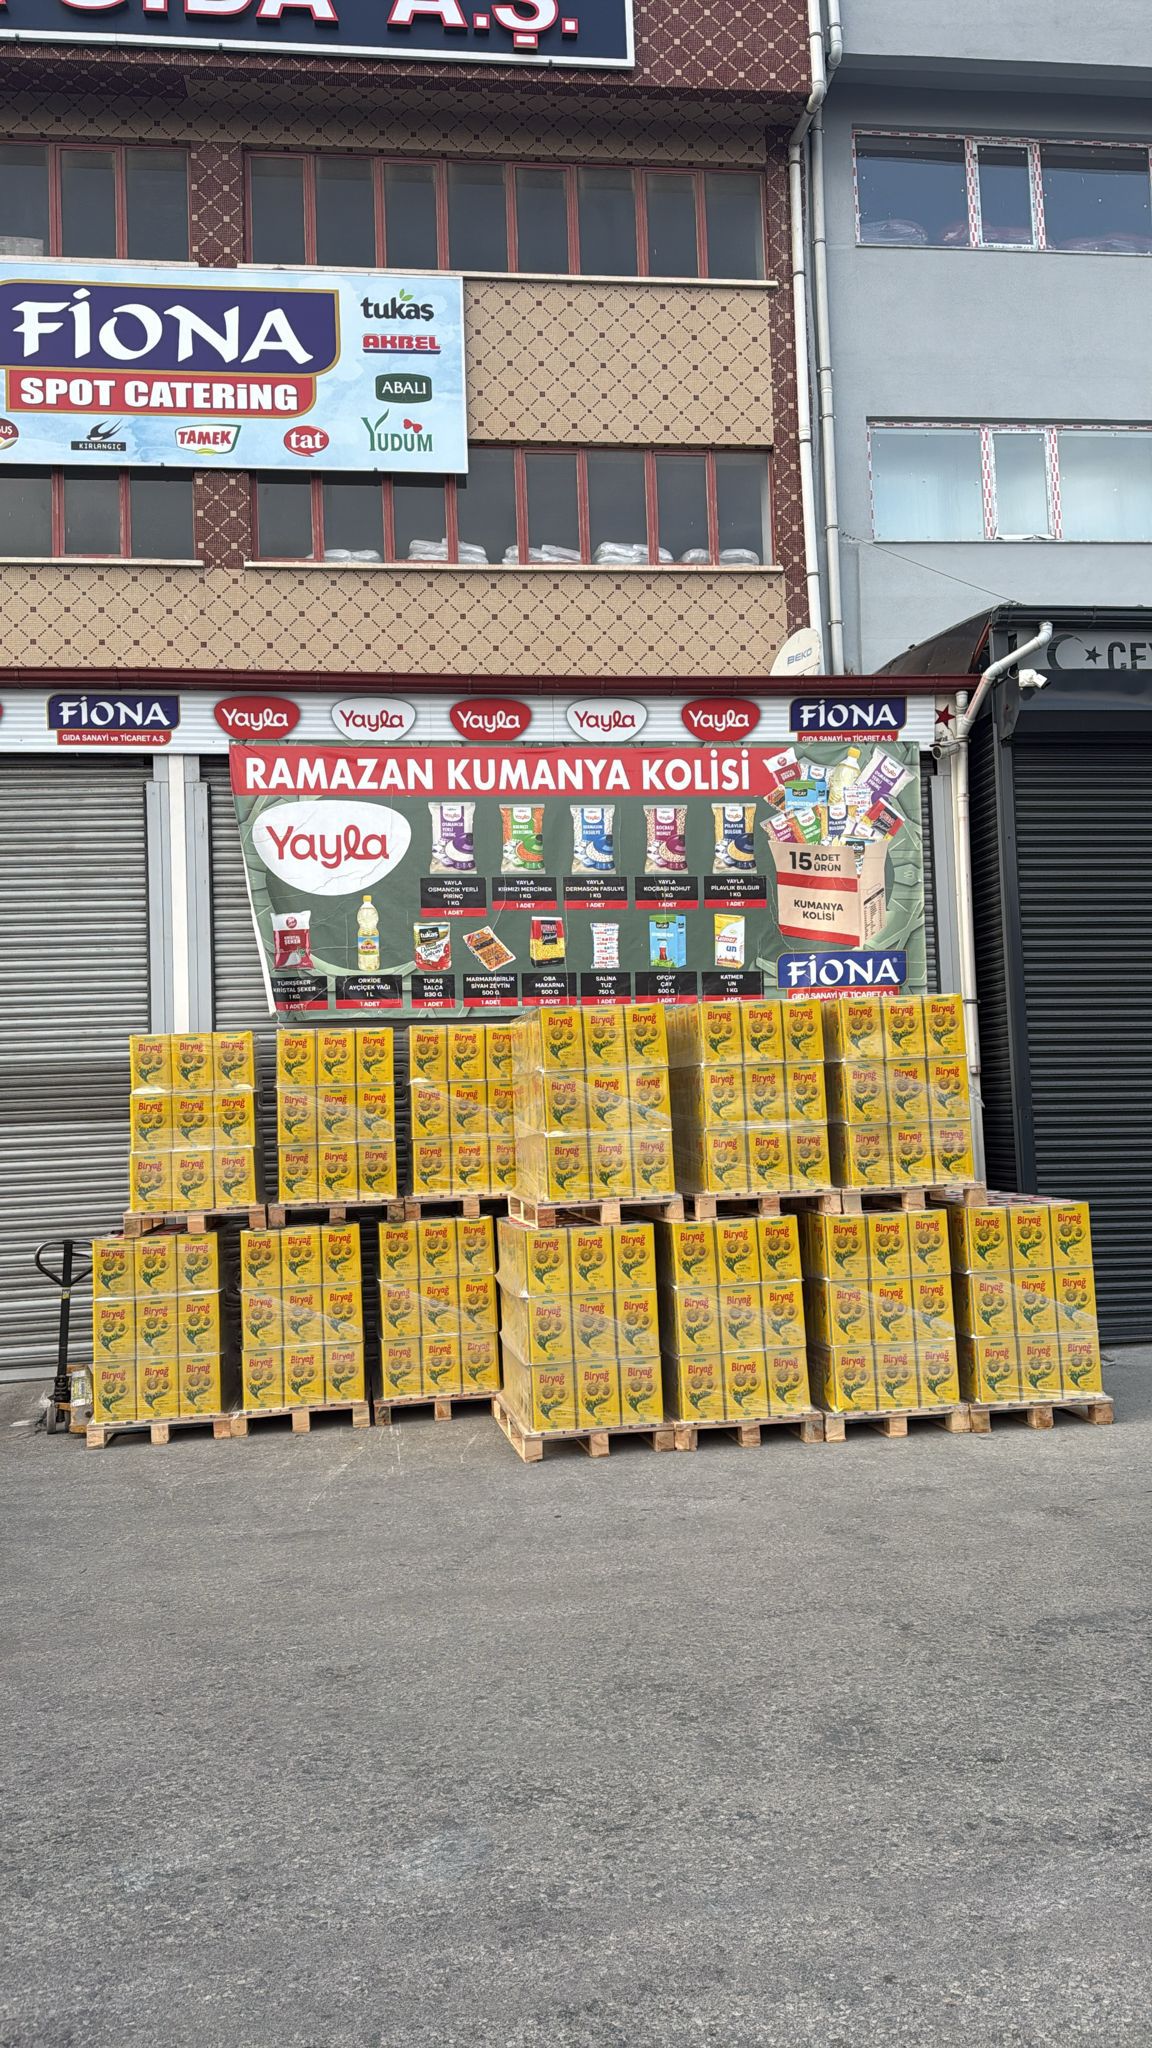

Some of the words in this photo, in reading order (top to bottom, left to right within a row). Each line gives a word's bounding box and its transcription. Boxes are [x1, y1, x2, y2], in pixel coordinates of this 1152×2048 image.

[360, 296, 434, 321] tukaş
[11, 287, 313, 365] FİONA
[362, 334, 441, 350] AKBEL
[20, 377, 115, 406] SPOT
[381, 381, 427, 395] ABALI
[361, 409, 433, 452] YUDUM
[178, 430, 232, 446] TAMEK
[289, 430, 324, 449] tat
[78, 442, 122, 451] KIRLANGIÇ
[787, 647, 812, 665] BEKO
[58, 696, 170, 727] FİONA
[799, 699, 898, 728] FİONA
[221, 708, 289, 731] Yayla
[339, 710, 404, 733] Yayla
[457, 710, 521, 733] Yayla
[574, 710, 636, 732] Yayla
[688, 710, 750, 732] Yayla
[82, 733, 109, 741] SANAYİ
[120, 733, 151, 742] TİCARET
[245, 757, 434, 790] RAMAZAN
[447, 758, 630, 791] KUMANYA
[642, 749, 750, 791] KOLİSİ
[266, 824, 390, 869] Yayla
[789, 850, 813, 871] 15
[814, 853, 841, 862] ADET
[813, 862, 842, 872] ÜRÜN
[793, 899, 844, 912] KUMANYA
[802, 909, 836, 922] KOLİSİ
[726, 944, 738, 953] un
[786, 954, 901, 987] FİONA
[466, 975, 516, 983] MARMARABİRLİK
[348, 984, 376, 992] AYÇİÇEK
[376, 983, 391, 991] YAĞI
[788, 1008, 813, 1021] Biryağ
[848, 1006, 873, 1018] Biryağ
[931, 1004, 956, 1015] Biryağ
[547, 1016, 575, 1029] Biryağ
[707, 1010, 732, 1023] Biryağ
[283, 1038, 308, 1049] Biryağ
[362, 1035, 385, 1048] Biryağ
[416, 1034, 440, 1045] Biryağ
[138, 1102, 163, 1112] Biryağ
[975, 1218, 1000, 1229] Biryağ
[1058, 1213, 1082, 1225] Biryağ
[386, 1231, 409, 1241] Biryağ
[833, 1224, 858, 1236] Biryağ
[247, 1239, 272, 1249] Biryağ
[328, 1233, 352, 1247] Biryağ
[679, 1232, 705, 1243] Biryağ
[534, 1239, 559, 1251] Biryağ
[100, 1249, 124, 1258] Biryağ
[186, 1364, 210, 1374] Biryağ
[731, 1362, 756, 1373] Biryağ
[584, 1370, 609, 1383] Biryağ
